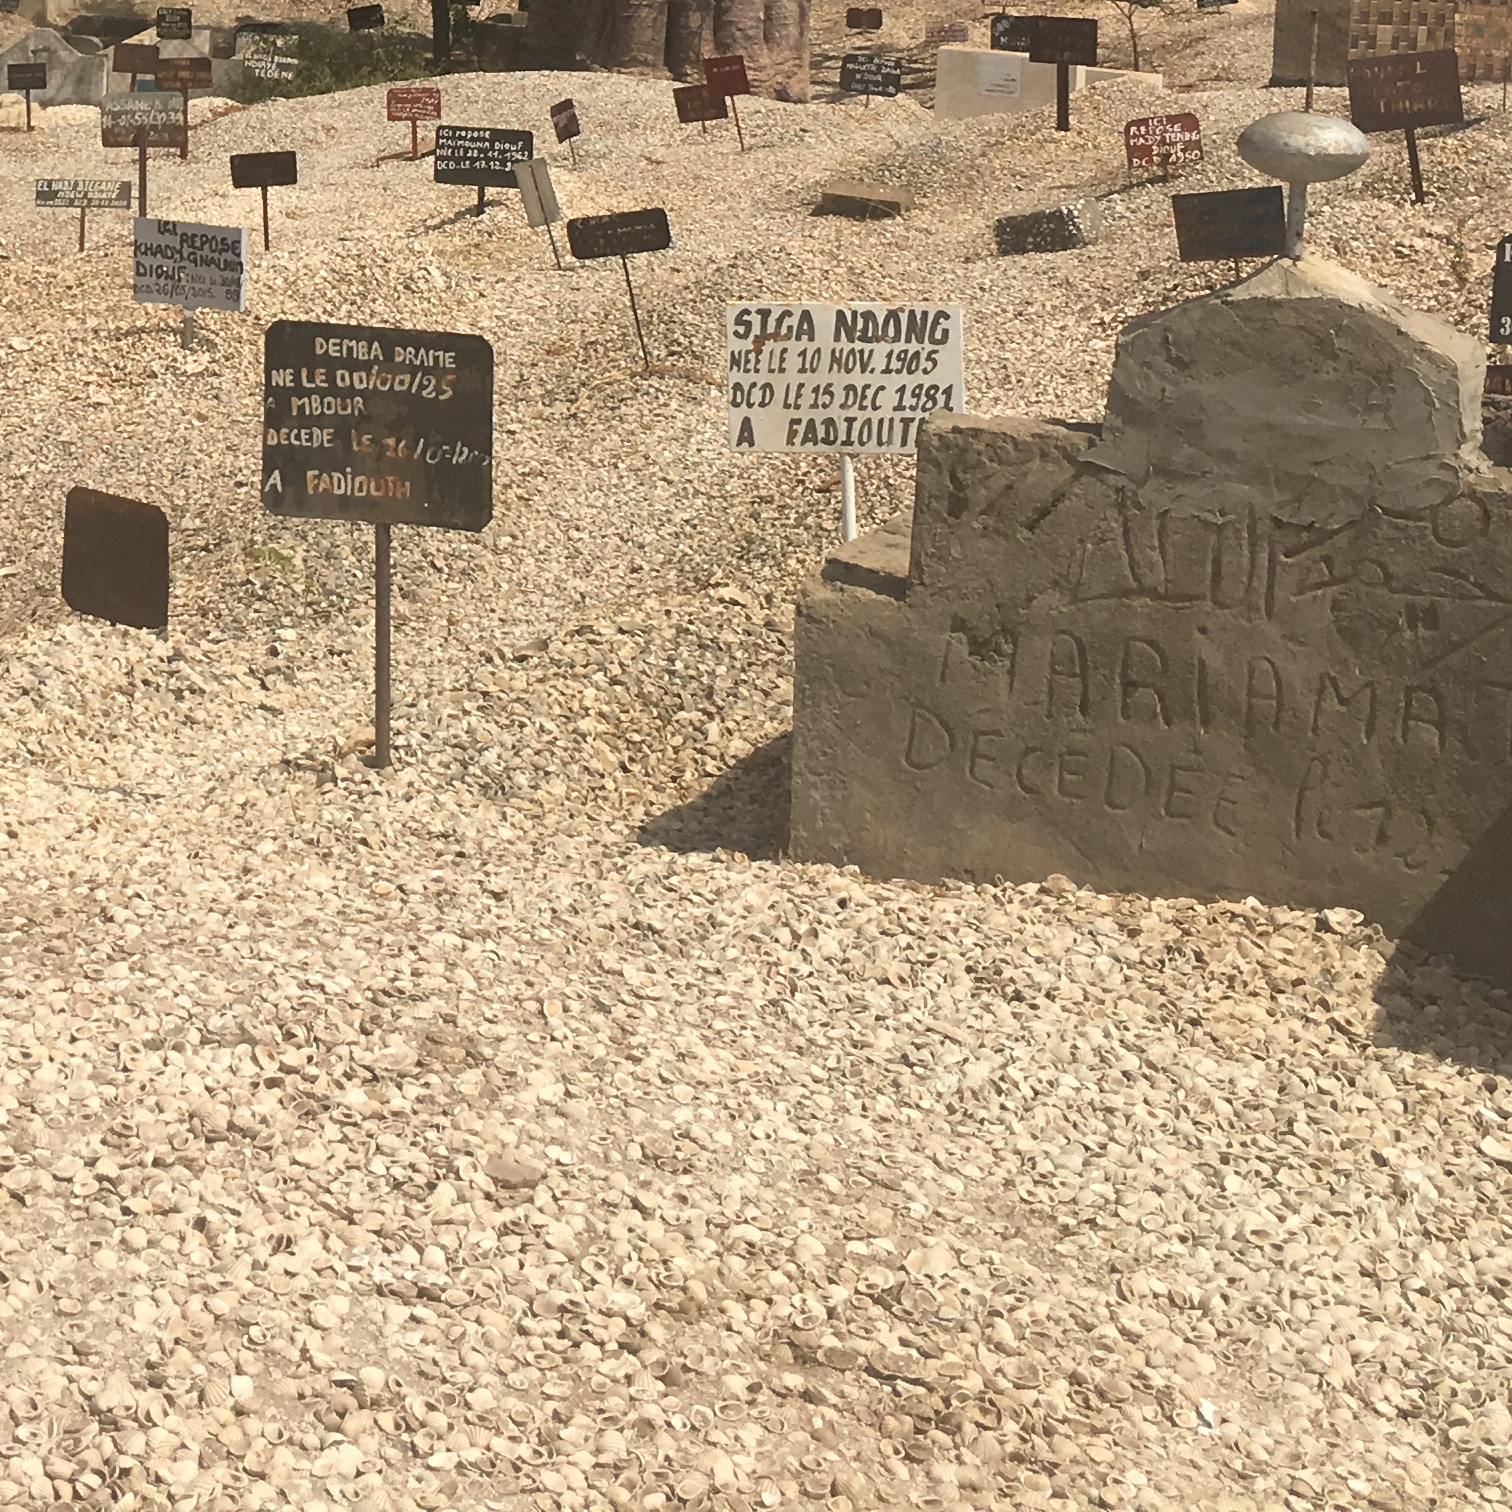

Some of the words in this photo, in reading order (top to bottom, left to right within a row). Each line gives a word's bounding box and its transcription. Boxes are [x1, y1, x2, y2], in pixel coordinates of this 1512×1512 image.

[1130, 123, 1182, 136] REPOSE
[1148, 117, 1167, 126] ICI
[179, 232, 241, 258] REPOSE
[732, 307, 816, 342] SIGA
[833, 308, 951, 345] NDONG
[314, 337, 384, 360] DEMBA
[394, 346, 456, 368] DRAME
[729, 348, 763, 374] NEE
[767, 347, 787, 374] LE
[796, 346, 822, 374] 10
[880, 348, 939, 376] 1905
[271, 369, 295, 387] NE
[301, 367, 329, 388] LE
[336, 364, 457, 400] 00/00/25
[291, 394, 367, 416] MBOUR
[730, 381, 775, 409] DCD
[782, 382, 805, 410] LE
[808, 382, 836, 410] 15
[839, 383, 887, 412] DEC
[892, 383, 955, 413] 1981
[266, 427, 335, 448] DECEDE
[351, 429, 374, 452] LE
[735, 415, 756, 449] A
[264, 469, 283, 493] A
